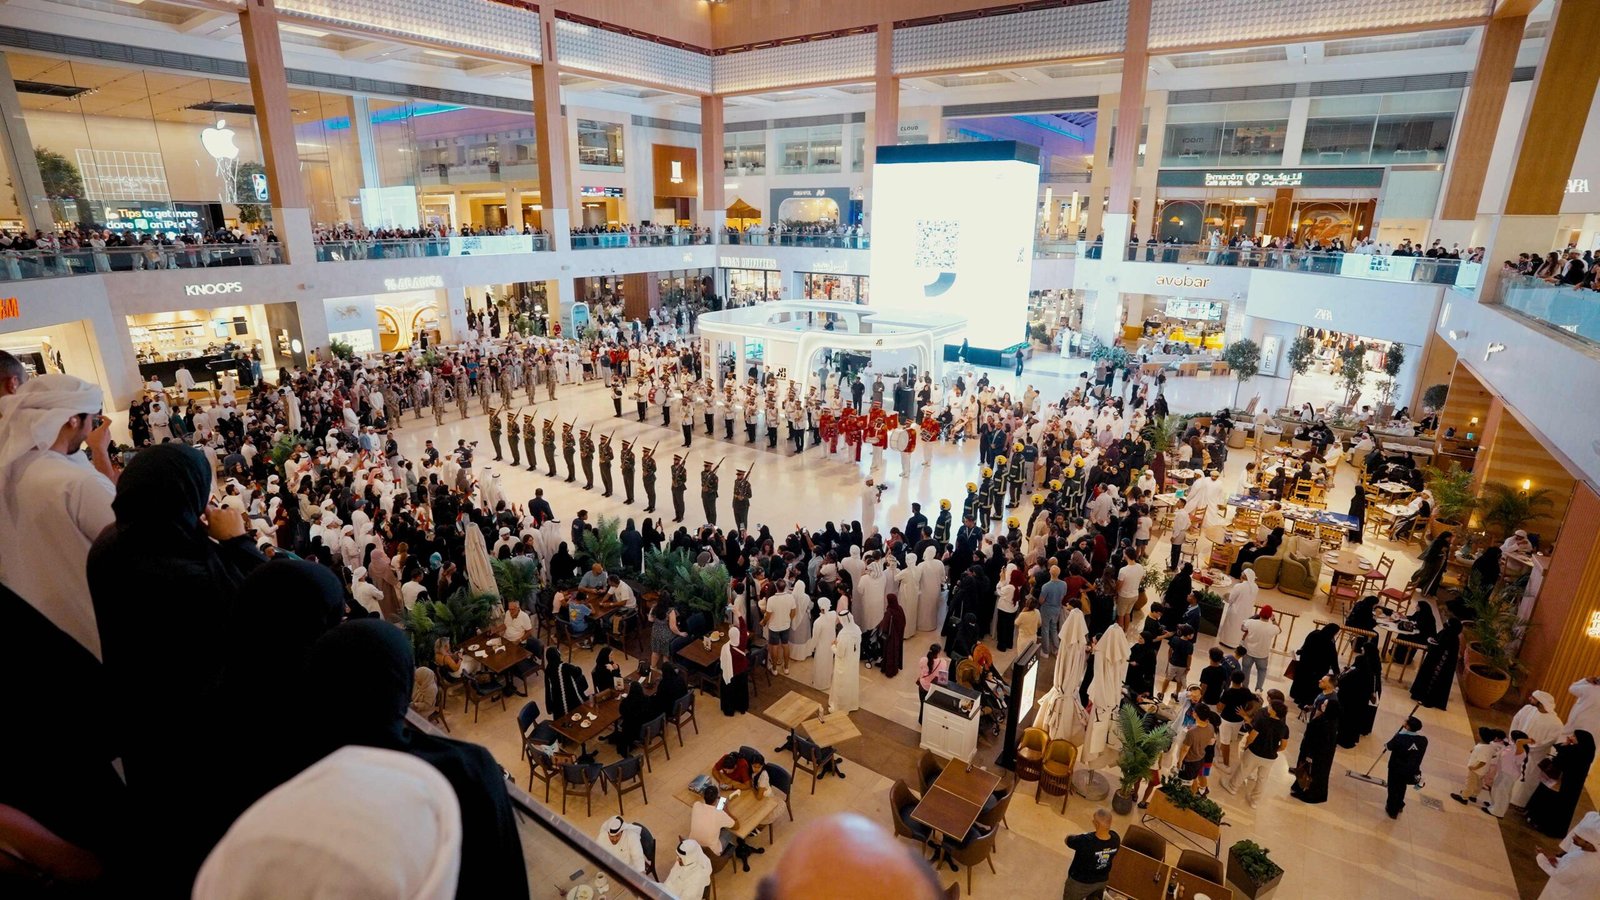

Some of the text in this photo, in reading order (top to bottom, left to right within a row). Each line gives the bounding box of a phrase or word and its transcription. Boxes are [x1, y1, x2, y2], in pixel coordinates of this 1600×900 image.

[1564, 178, 1591, 193] ARA
[118, 208, 141, 219] Tips
[141, 209, 154, 218] to
[154, 210, 172, 221] get
[106, 220, 134, 229] done
[1155, 274, 1211, 288] avobar
[184, 281, 243, 296] KNOOPS
